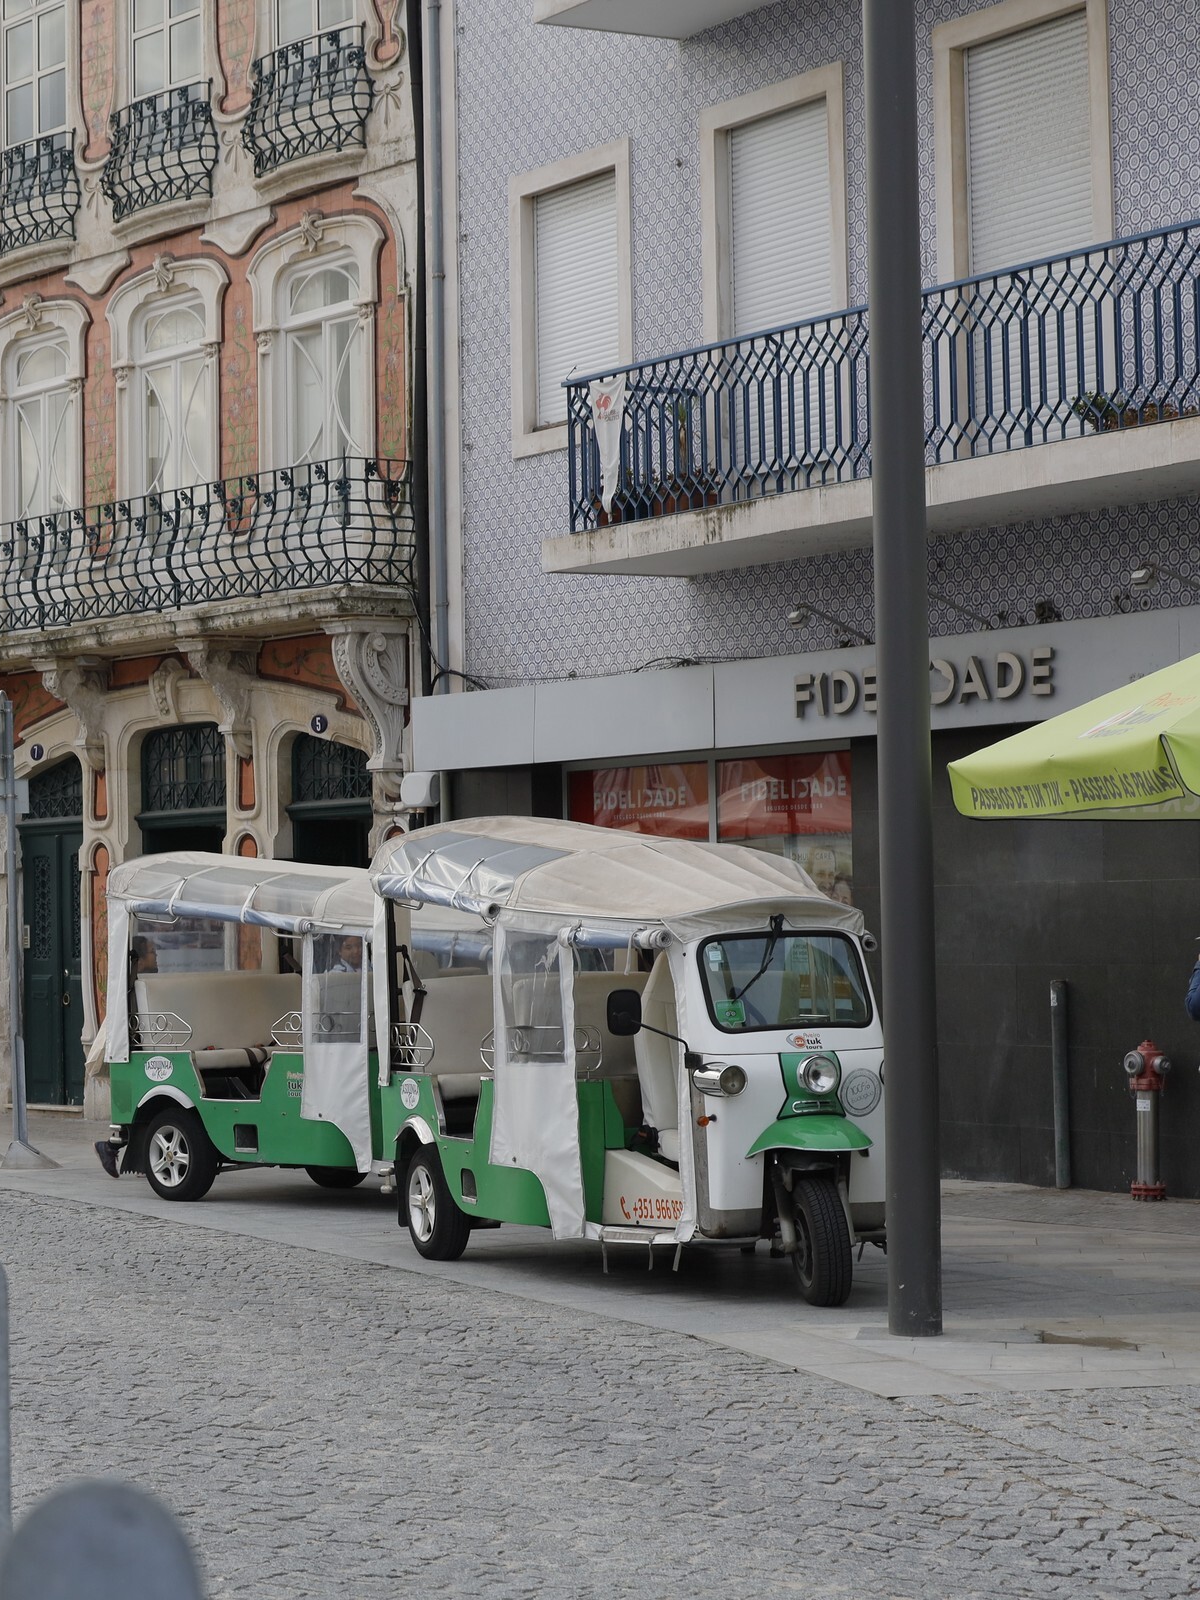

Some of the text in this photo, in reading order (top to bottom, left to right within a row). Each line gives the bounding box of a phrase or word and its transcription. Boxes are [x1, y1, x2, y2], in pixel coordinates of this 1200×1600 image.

[794, 646, 1054, 718] FIDEDADE
[315, 716, 321, 732] 5
[593, 785, 686, 811] FIDELIDADE
[741, 775, 847, 801] FIDELIDADE
[970, 787, 1015, 810] PASSEIOS
[1010, 785, 1028, 809] DE
[1022, 783, 1047, 809] TUK
[1041, 780, 1064, 807] TUK
[1068, 774, 1123, 803] PASSEIOS
[1114, 767, 1137, 798] ÀS
[1130, 766, 1177, 797] PRAIAS
[806, 1037, 822, 1045] tuk
[632, 1198, 654, 1219] +351
[655, 1198, 672, 1220] 966
